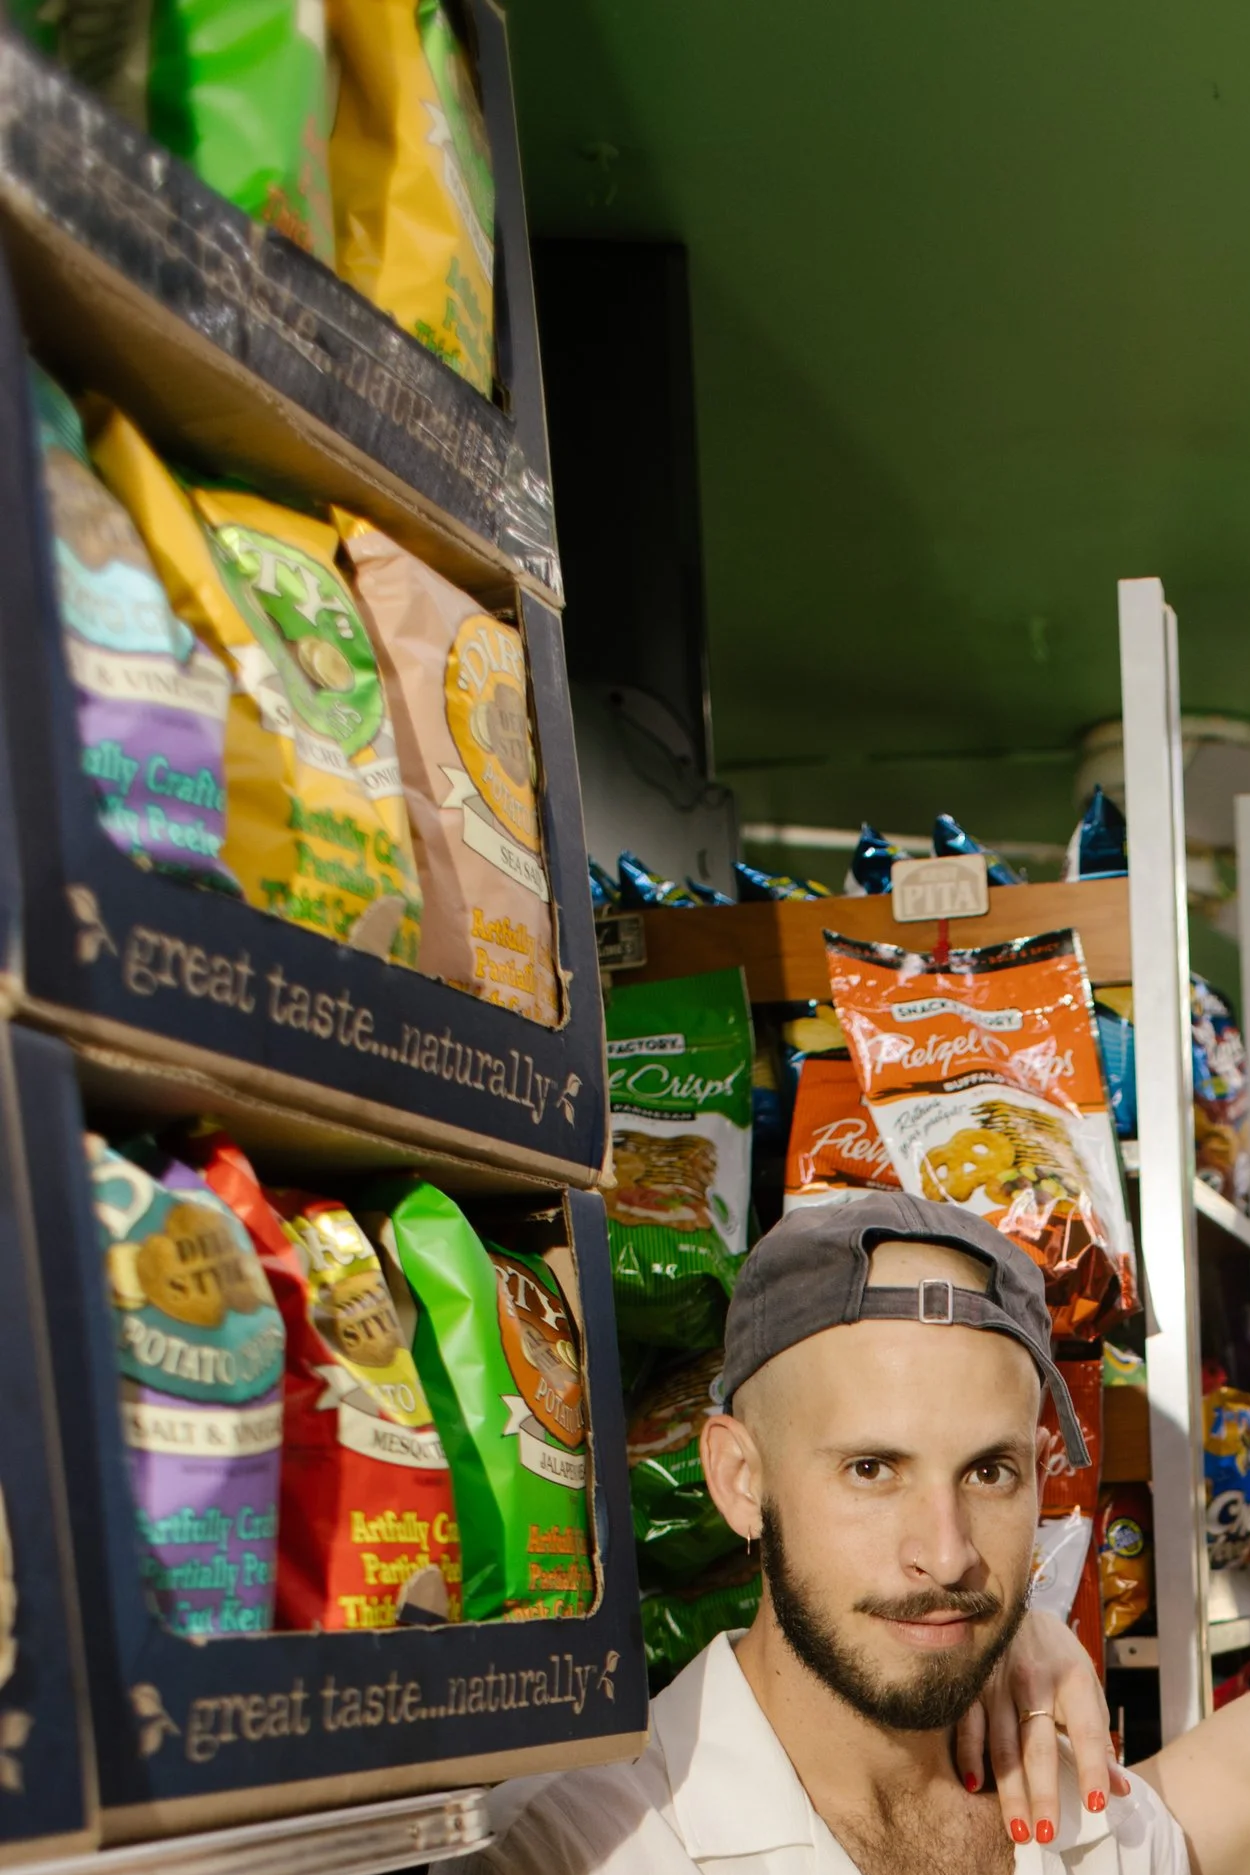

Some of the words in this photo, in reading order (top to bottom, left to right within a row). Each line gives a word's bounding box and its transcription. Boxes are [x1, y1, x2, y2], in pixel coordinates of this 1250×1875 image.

[902, 879, 981, 917] PITA
[125, 925, 258, 1014] great
[866, 1028, 982, 1077] Pretzel
[186, 1677, 311, 1763] great
